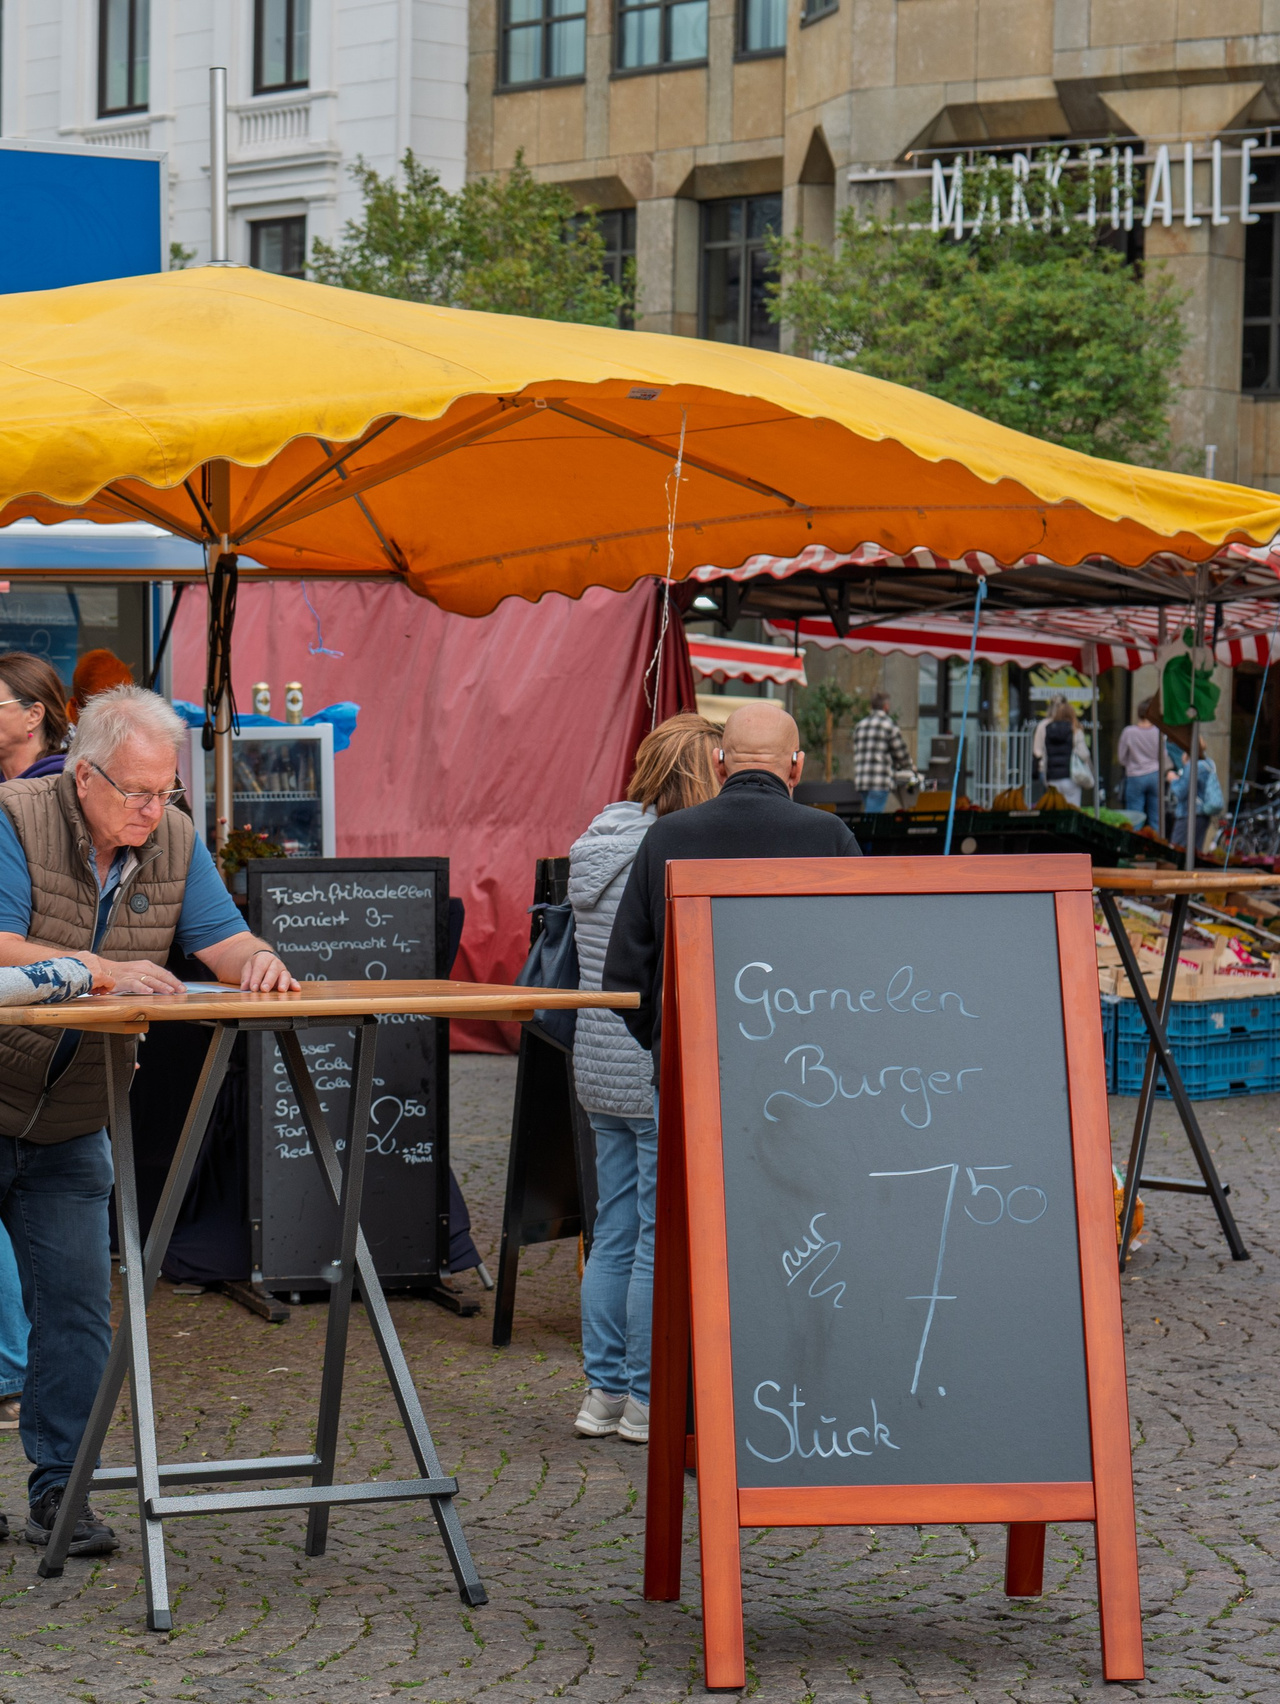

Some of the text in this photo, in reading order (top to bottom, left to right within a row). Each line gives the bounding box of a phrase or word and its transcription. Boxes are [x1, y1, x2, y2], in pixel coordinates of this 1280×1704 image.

[272, 910, 350, 933] paniert
[734, 961, 981, 1042] Garnelen
[315, 1057, 352, 1071] Cola
[315, 1076, 351, 1091] Cola
[763, 1043, 984, 1130] Burger
[781, 1211, 829, 1279] nur
[745, 1379, 901, 1464] Stück
